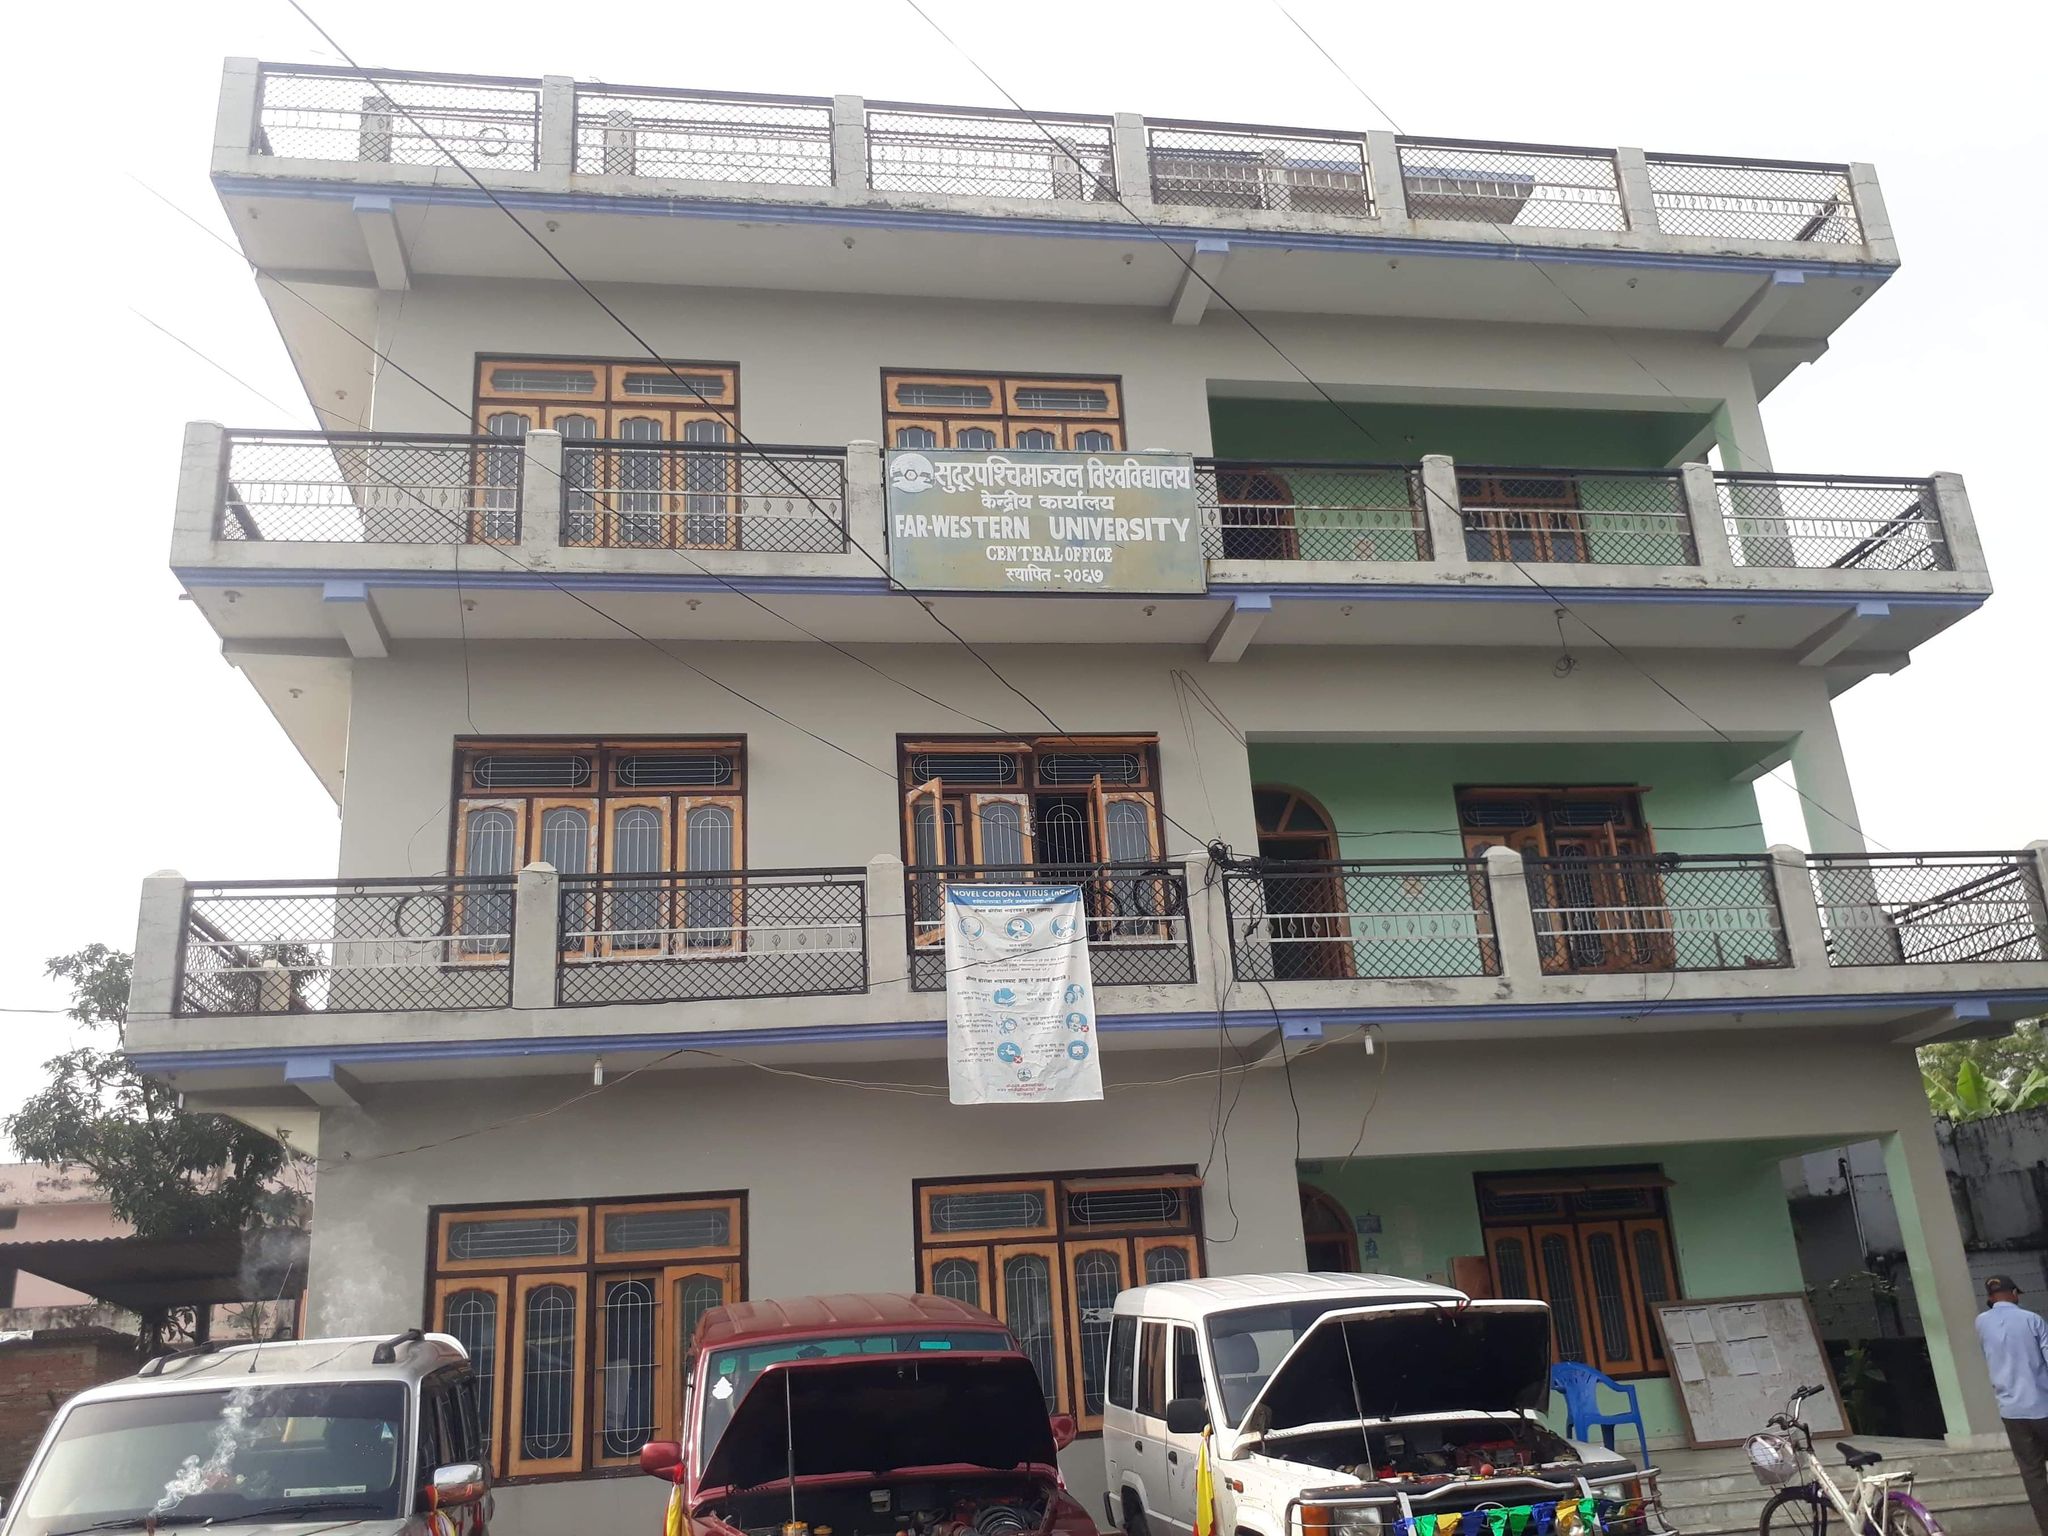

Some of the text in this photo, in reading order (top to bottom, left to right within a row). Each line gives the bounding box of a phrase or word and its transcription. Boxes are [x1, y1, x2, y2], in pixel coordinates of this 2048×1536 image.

[934, 456, 1190, 493] सुदूरपश्चिमाञ्चल विश्वविद्यालय
[980, 490, 1115, 512] केन्द्रीय कार्यालय
[895, 515, 1190, 542] FAR-WESTERN UNIVERSITY
[986, 545, 1113, 563] CENTRAL OFFICE
[1005, 564, 1051, 583] स्थापित
[1063, 569, 1104, 583] २०६७
[952, 889, 979, 897] NOVEL
[982, 890, 1020, 898] CORONA
[1023, 889, 1048, 897] VIRUS
